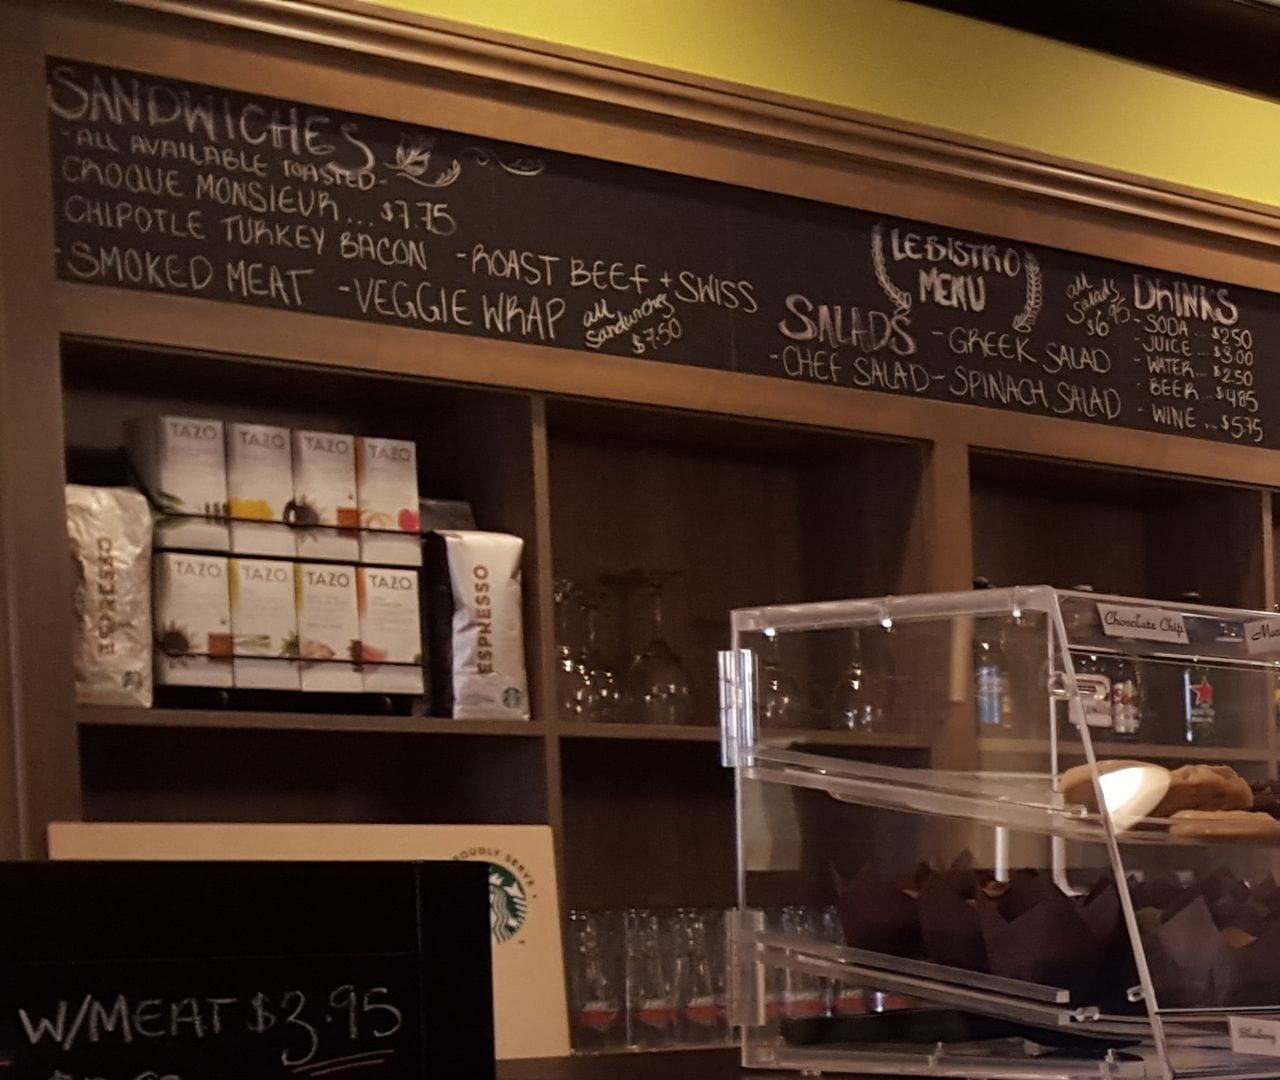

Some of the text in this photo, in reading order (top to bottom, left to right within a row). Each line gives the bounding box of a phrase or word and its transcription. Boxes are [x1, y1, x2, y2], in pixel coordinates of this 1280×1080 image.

[48, 67, 376, 174] SANDWICHES
[62, 155, 184, 197] CROQUE
[131, 134, 268, 177] AVAILABLE
[65, 195, 205, 239] CHIPOTLE
[219, 214, 325, 255] TURKEY
[340, 231, 427, 271] BACON
[570, 256, 649, 294] BEEF
[674, 271, 758, 313] SWISS
[67, 240, 213, 290] SMOKED
[227, 260, 314, 306] MEAT
[482, 291, 565, 341] WRAP
[919, 267, 986, 312] MENU
[1133, 274, 1239, 326] DRINKS
[631, 317, 682, 354] $7.50
[778, 294, 916, 356] SALADS
[1144, 314, 1189, 338] SODA
[1042, 343, 1111, 374] SALAD
[1142, 337, 1192, 357] JUICE
[1147, 354, 1195, 379] WATER
[853, 357, 929, 392] SALAD
[1053, 381, 1121, 420] SALAD
[1150, 378, 1199, 401] BEER
[1152, 403, 1196, 430] WINE
[169, 421, 412, 462] TAZO TAZO TAZO TAZO
[174, 559, 413, 591] TAZO TAZO TAZO TAZO
[475, 564, 494, 675] ESPRESSO
[250, 984, 402, 1067] $3.95
